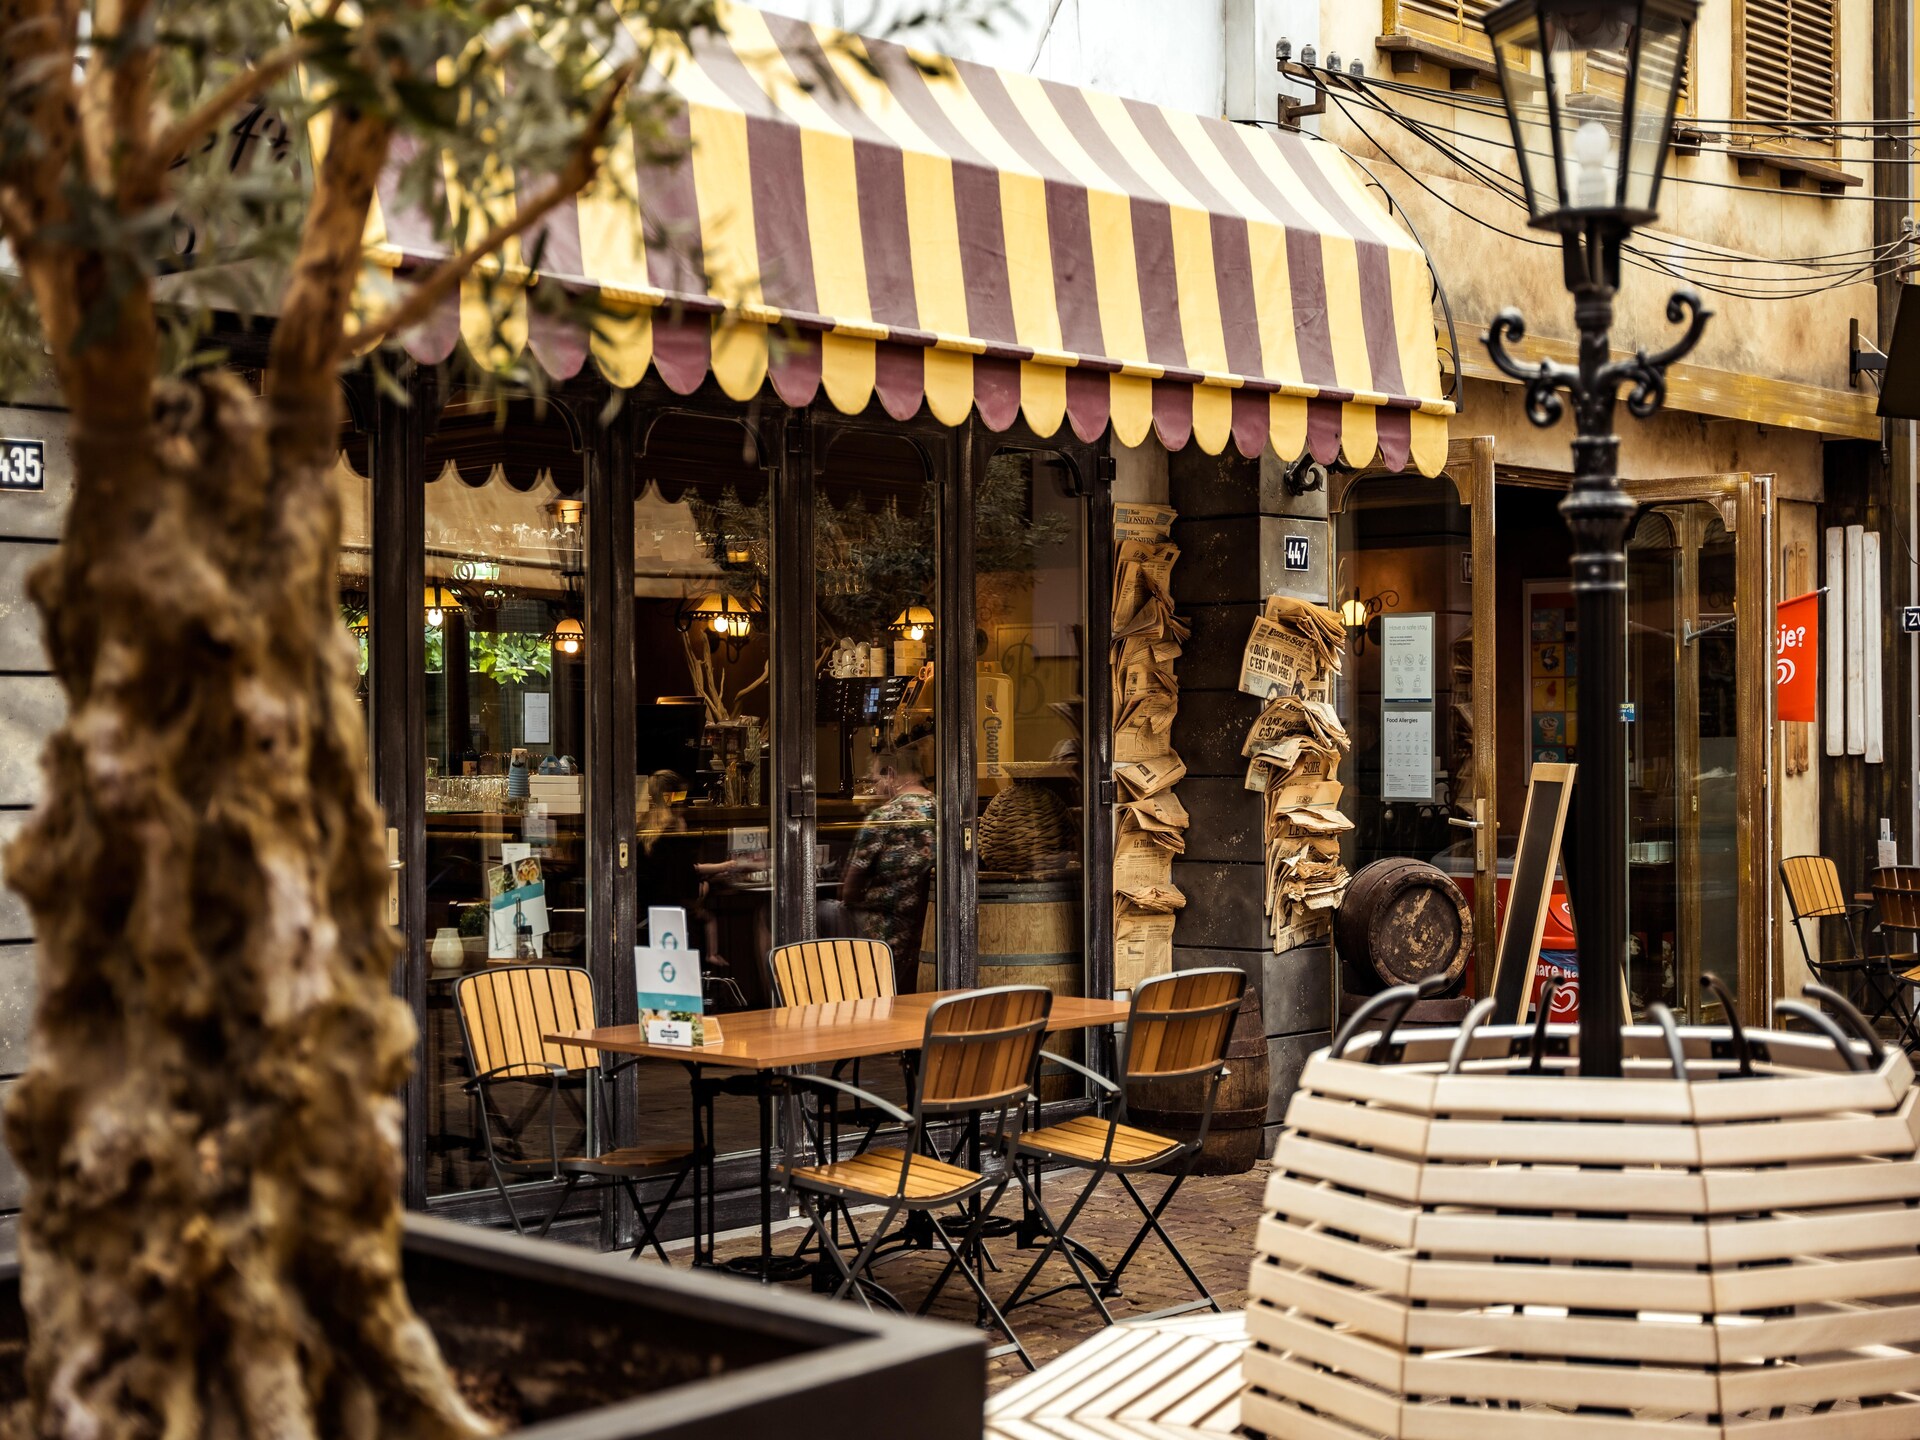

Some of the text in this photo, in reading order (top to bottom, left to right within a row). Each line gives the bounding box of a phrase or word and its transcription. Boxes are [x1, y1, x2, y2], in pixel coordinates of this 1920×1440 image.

[0, 446, 41, 483] 435
[1288, 541, 1308, 566] 447
[1908, 612, 1920, 627] Z
[1289, 636, 1307, 648] Soir
[1776, 624, 1806, 654] je?
[982, 716, 1002, 779] Chocomel
[1302, 761, 1321, 774] SOIR
